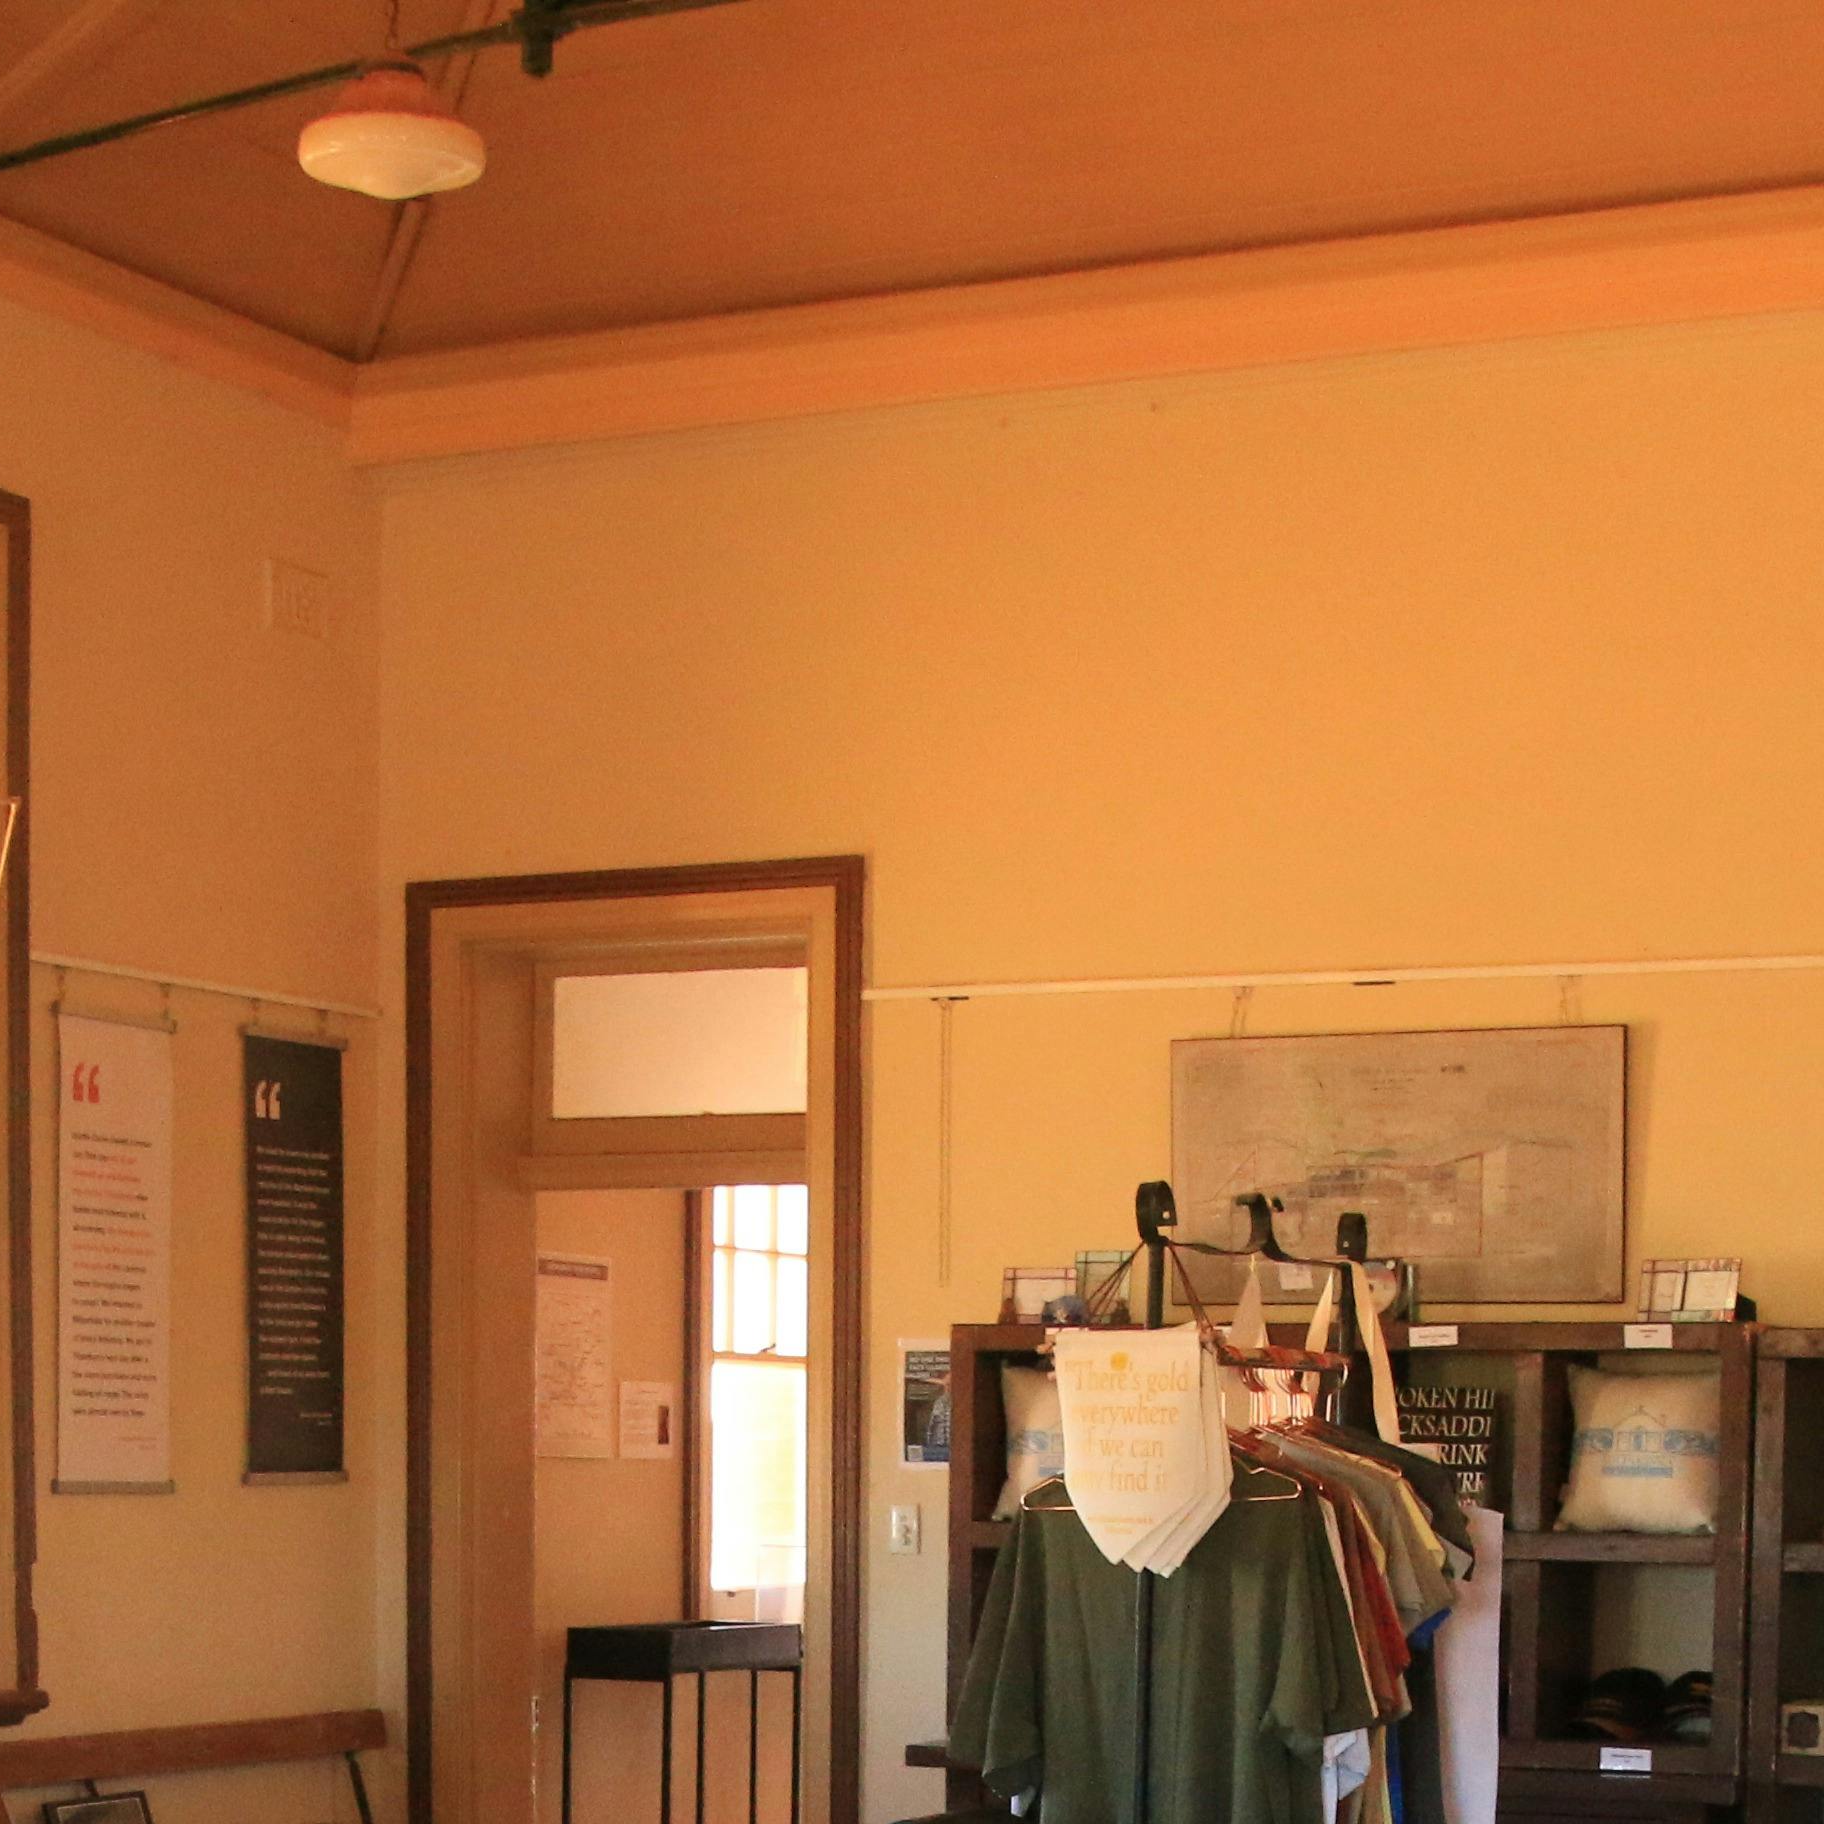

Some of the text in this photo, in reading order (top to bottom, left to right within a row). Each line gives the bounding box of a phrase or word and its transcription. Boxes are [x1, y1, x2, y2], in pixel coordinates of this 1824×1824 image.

[1147, 1361, 1188, 1401] gold
[1398, 1387, 1457, 1409] OKEN
[1099, 1439, 1125, 1458] we
[1131, 1438, 1164, 1459] can
[1109, 1460, 1149, 1493] find
